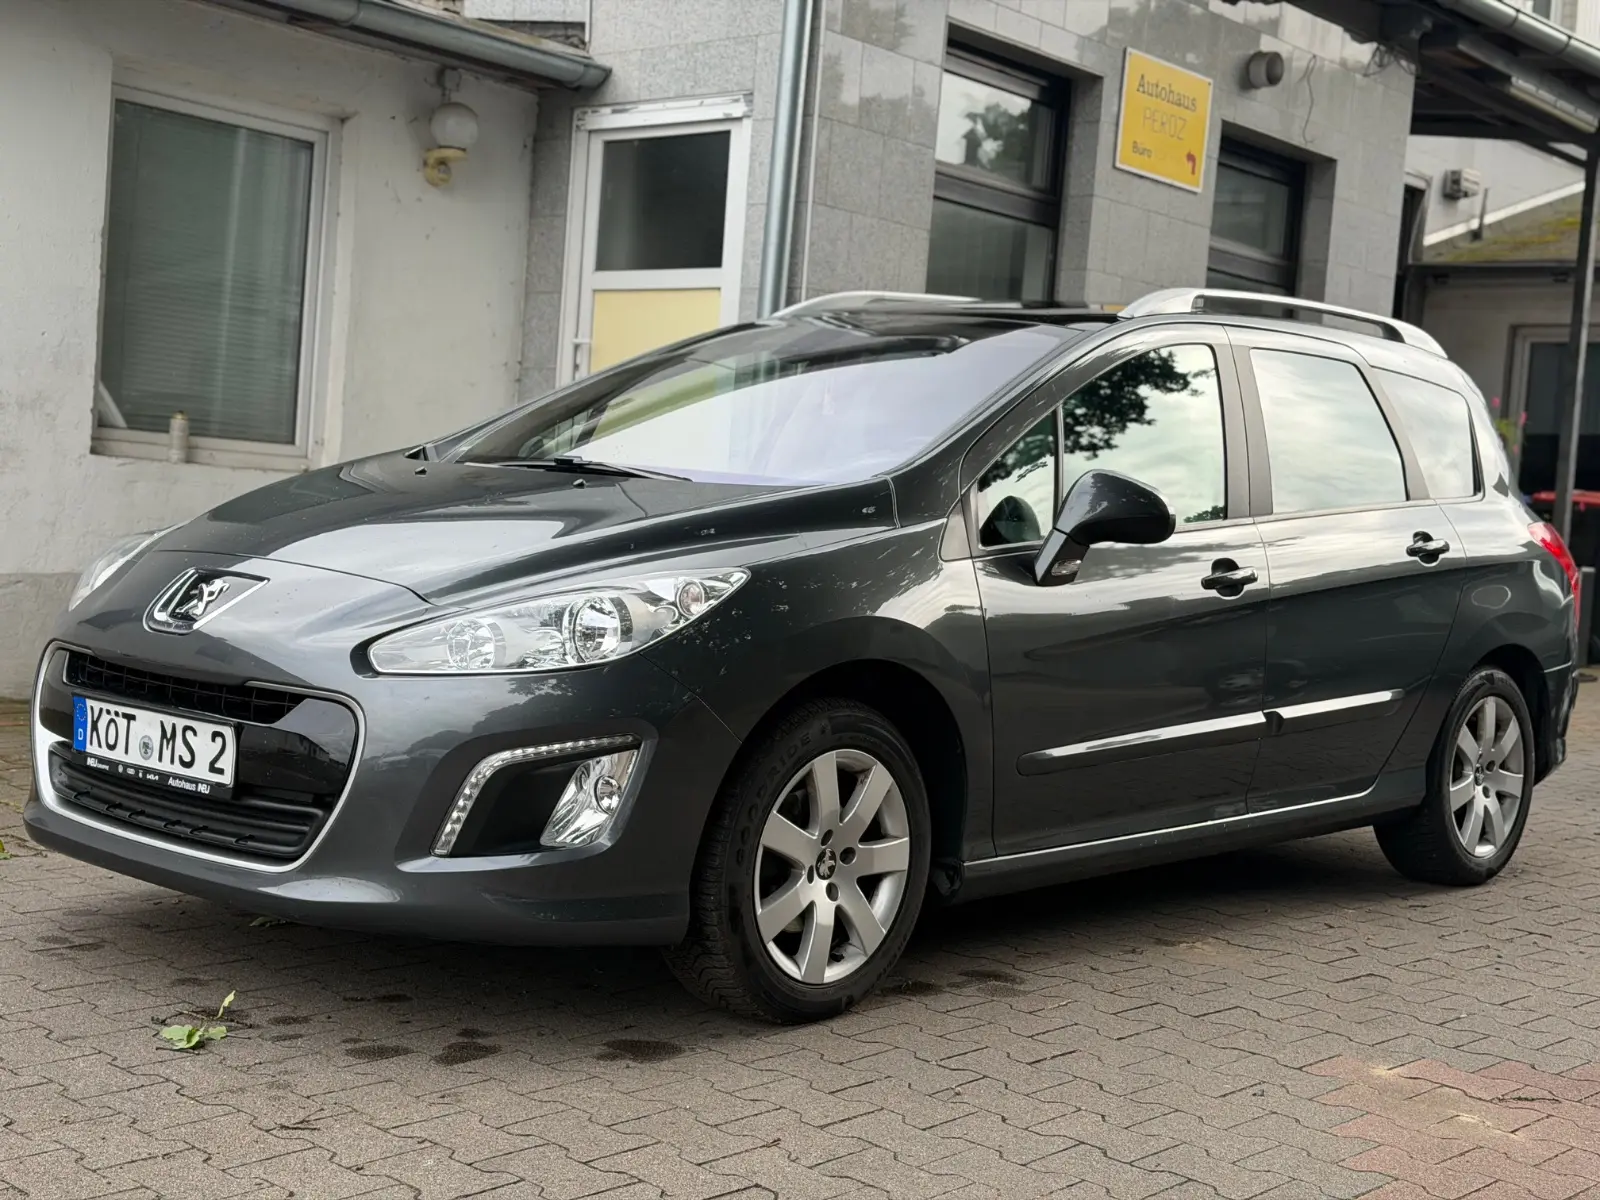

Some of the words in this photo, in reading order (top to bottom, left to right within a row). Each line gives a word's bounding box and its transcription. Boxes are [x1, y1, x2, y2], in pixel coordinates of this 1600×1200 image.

[1136, 73, 1197, 113] Autohaus
[77, 727, 84, 741] D
[89, 704, 137, 755] KÖT
[157, 719, 198, 770] MS
[208, 730, 227, 776] 2
[168, 776, 196, 791] Autohaus
